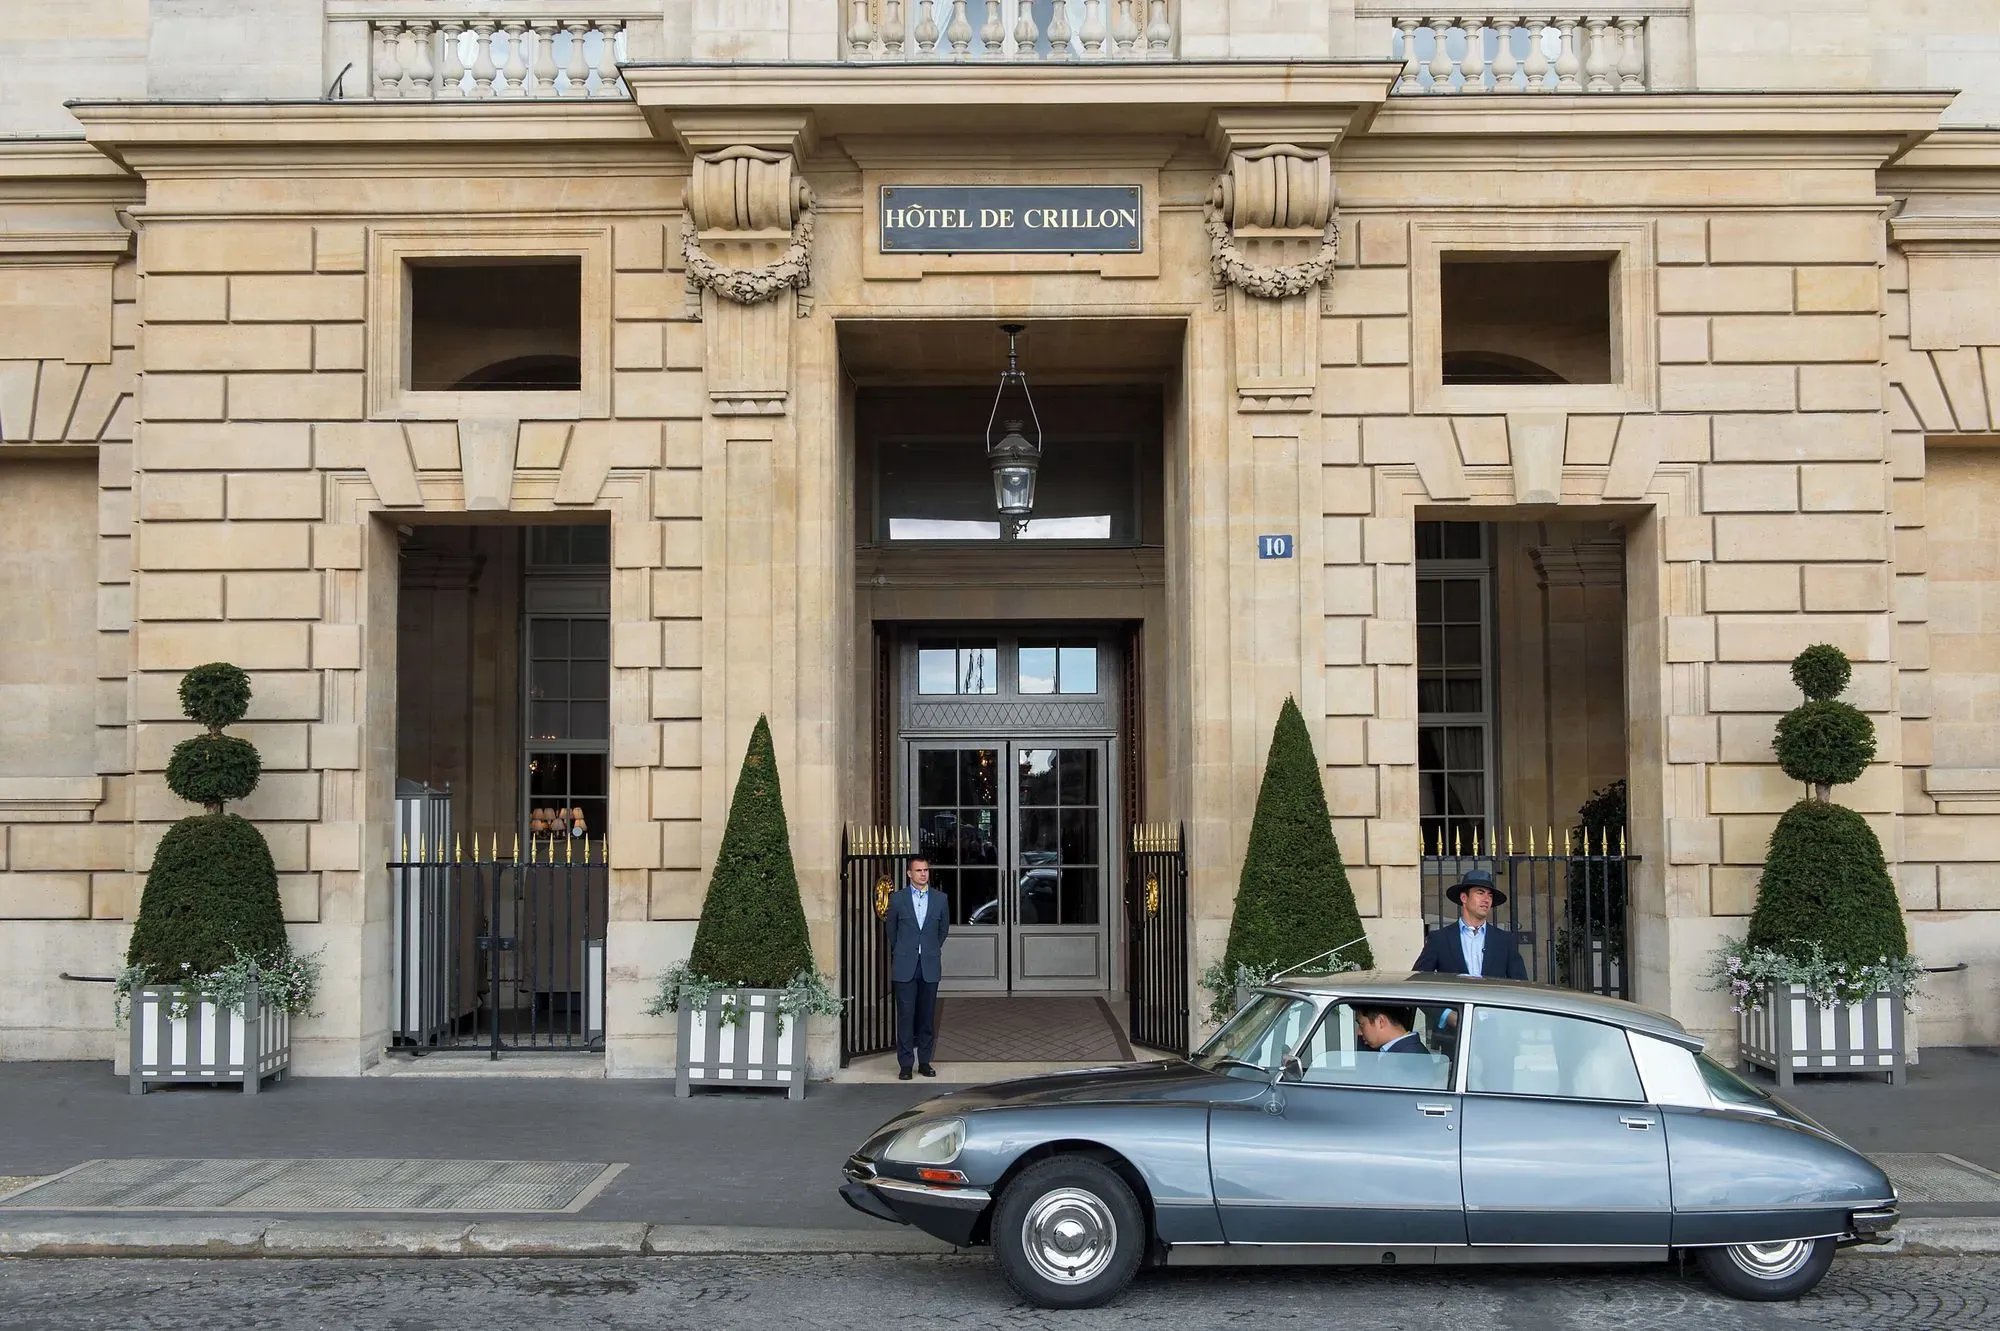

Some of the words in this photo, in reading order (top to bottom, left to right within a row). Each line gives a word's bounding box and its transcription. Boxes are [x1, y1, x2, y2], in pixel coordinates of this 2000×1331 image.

[980, 208, 1014, 228] DE
[1023, 208, 1136, 228] CRILLON
[1265, 537, 1285, 556] 10
